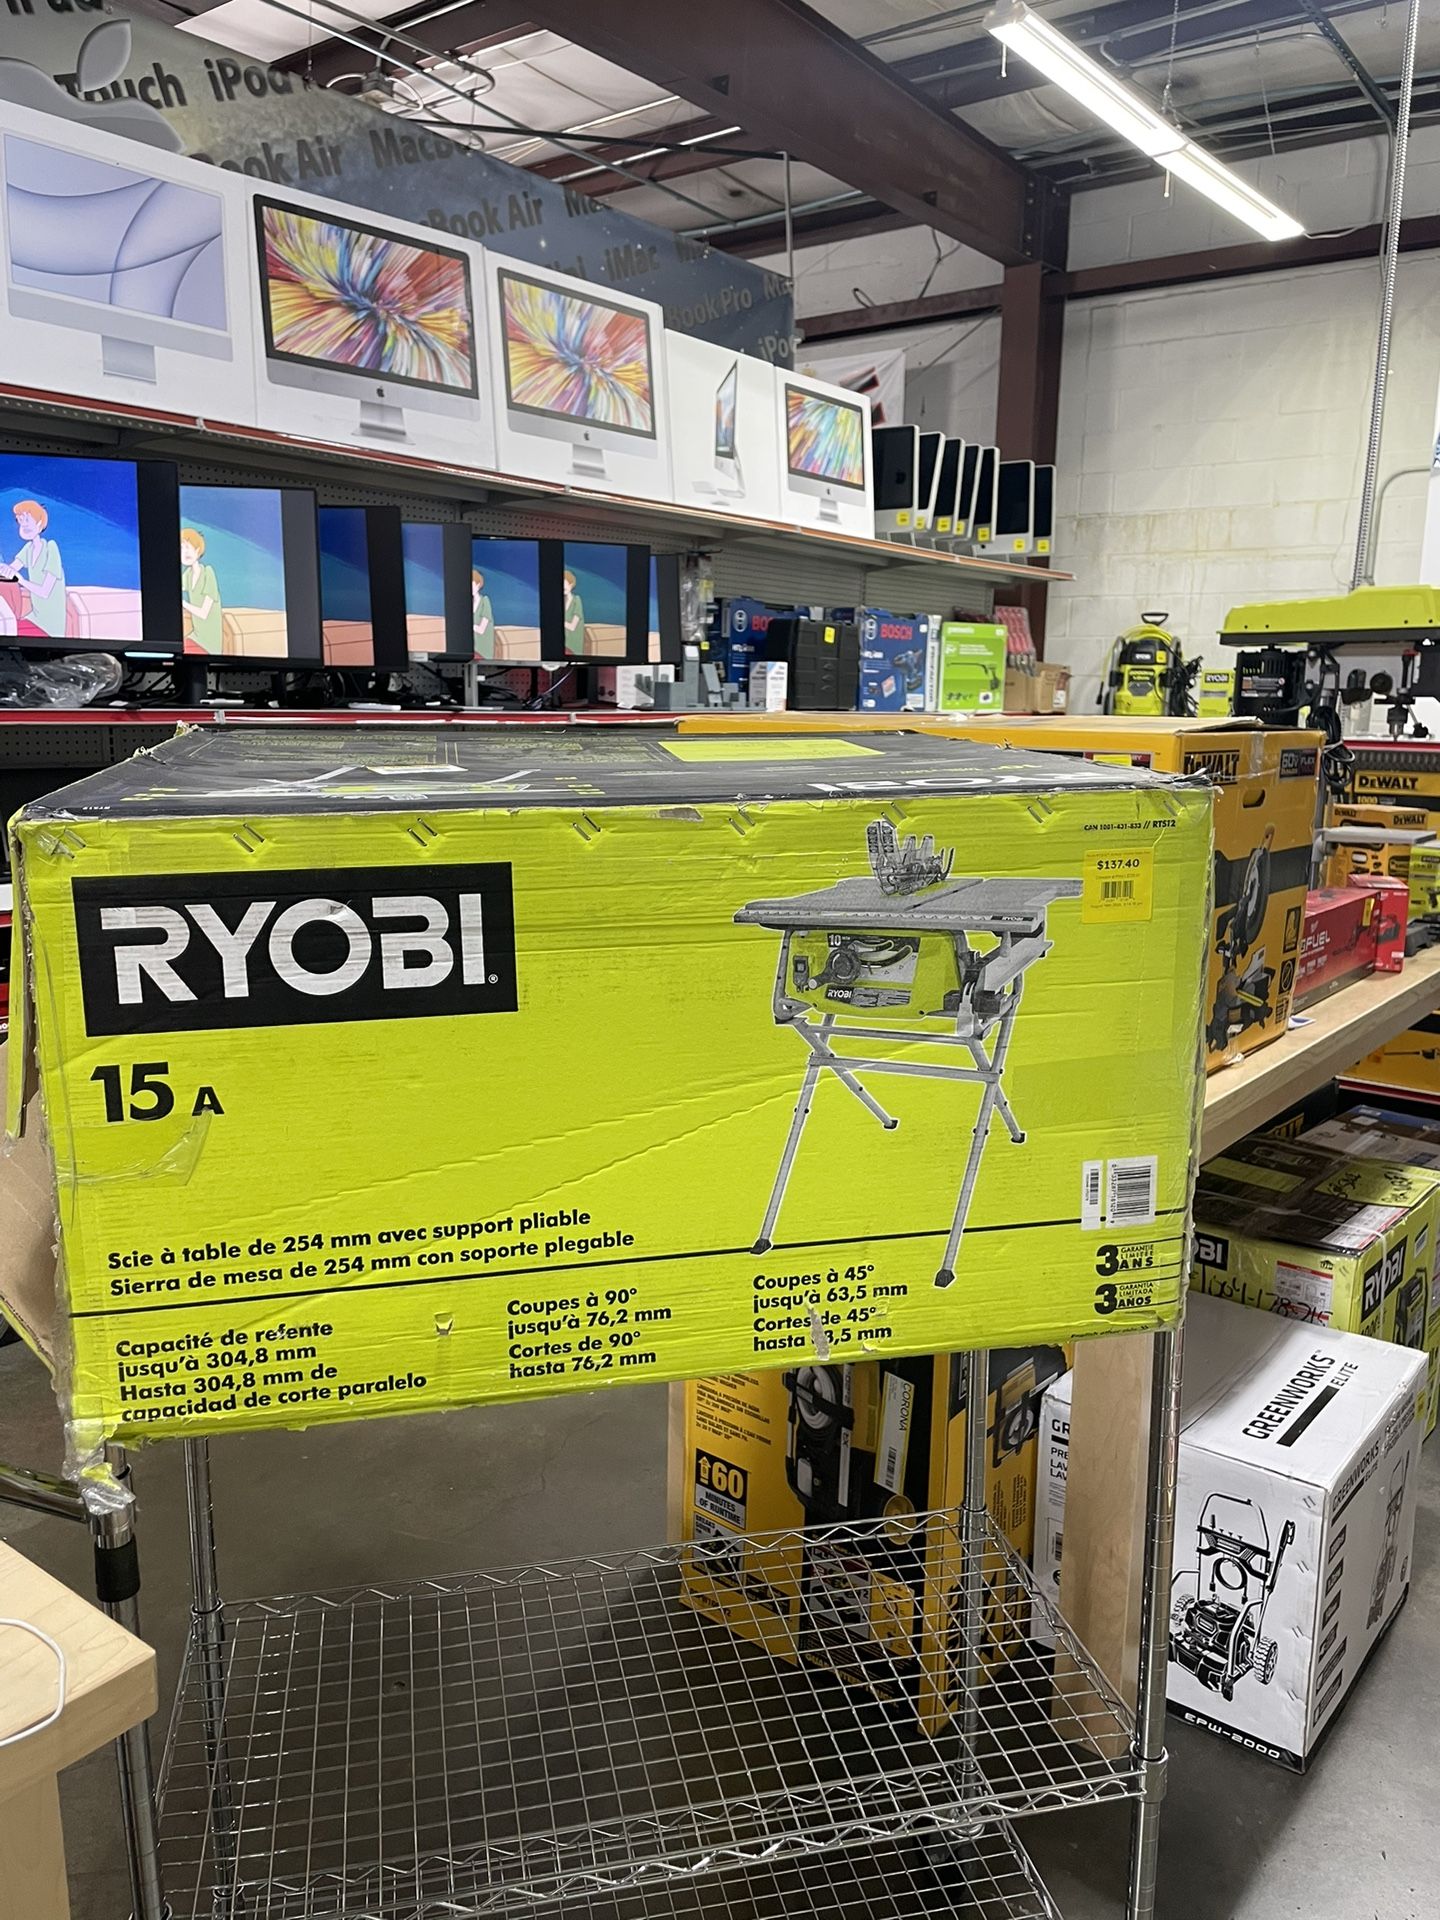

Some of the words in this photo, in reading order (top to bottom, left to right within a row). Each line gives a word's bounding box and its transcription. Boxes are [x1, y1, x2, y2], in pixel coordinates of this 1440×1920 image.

[296, 135, 343, 180] Air
[508, 191, 543, 231] Air
[880, 623, 913, 640] BOSCH
[1360, 776, 1418, 790] DEWALT
[1393, 814, 1426, 825] DEWALT
[1097, 858, 1140, 870] $137.40
[100, 894, 486, 1004] RYOBI
[91, 1062, 175, 1122] 15
[192, 1087, 225, 1116] A
[109, 1251, 153, 1269] Scie
[161, 1248, 175, 1264] à
[183, 1242, 240, 1261] table
[249, 1239, 276, 1255] de
[283, 1234, 323, 1252] 254
[331, 1234, 370, 1248] mm
[378, 1228, 426, 1243] avec
[433, 1217, 513, 1239] support
[520, 1209, 590, 1233] pliable
[111, 1277, 180, 1295] Sierra
[189, 1272, 215, 1288] de
[224, 1269, 282, 1284] mesa
[291, 1262, 316, 1278] de
[325, 1257, 364, 1275] 254
[372, 1256, 410, 1270] mm
[418, 1252, 453, 1265] con
[461, 1242, 538, 1263] soporte
[546, 1231, 634, 1257] plegable
[1095, 1244, 1118, 1277] 3
[1121, 1244, 1154, 1253] GARANTIE
[1120, 1256, 1154, 1270] ANS
[754, 1273, 820, 1293] Coupes
[827, 1268, 839, 1282] à
[845, 1264, 875, 1281] 45°
[827, 1285, 866, 1303] 63,5
[873, 1284, 907, 1297] mm
[1119, 1289, 1154, 1298] LIMITADA
[508, 1296, 579, 1319] Coupes
[586, 1293, 599, 1307] à
[606, 1288, 637, 1304] 90°
[1094, 1283, 1117, 1315] 3
[1117, 1296, 1152, 1308] AÑOS
[508, 1314, 579, 1339] jusqu'à
[587, 1310, 627, 1328] 76,2
[635, 1309, 671, 1321] mm
[754, 1316, 811, 1331] Cortes
[820, 1311, 841, 1325] de
[847, 1307, 876, 1322] 45°
[117, 1332, 213, 1357] Capacité
[221, 1329, 247, 1345] de
[256, 1322, 332, 1342] refente
[509, 1342, 571, 1358] Cortes
[579, 1335, 602, 1351] de
[609, 1331, 641, 1347] 90°
[754, 1335, 805, 1351] hasta
[858, 1327, 892, 1340] mm
[119, 1355, 198, 1382] jusqu'à
[207, 1348, 268, 1368] 304,8
[277, 1347, 316, 1360] mm
[510, 1361, 564, 1378] hasta
[572, 1354, 612, 1373] 76,2
[620, 1353, 655, 1365] mm
[1330, 1361, 1359, 1387] ELITE
[121, 1383, 185, 1401] Hasta
[194, 1373, 255, 1393] 304,8
[264, 1372, 303, 1385] mm
[311, 1364, 337, 1379] de
[122, 1394, 236, 1421] capacidad
[244, 1392, 271, 1407] de
[279, 1385, 331, 1403] corte
[339, 1373, 426, 1400] paralelo
[1243, 1352, 1336, 1440] GREENWORKS
[898, 1383, 912, 1431] CORONA
[711, 1461, 744, 1499] 60
[699, 1498, 710, 1510] OF
[710, 1501, 741, 1524] RUNTIME
[705, 1490, 736, 1513] MINUTES
[1184, 1712, 1281, 1759] EPW-2000
